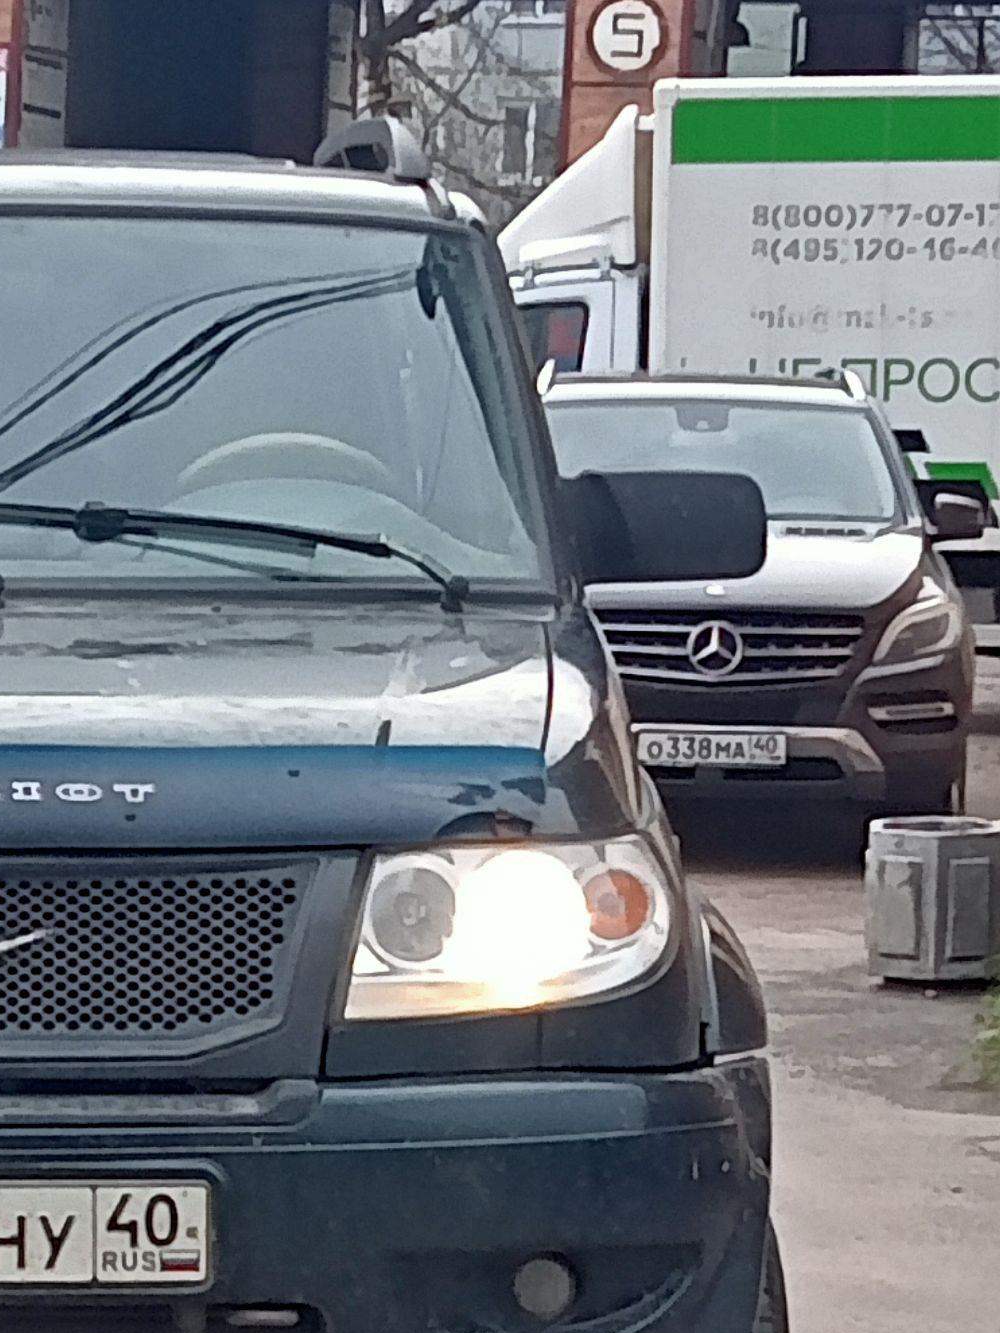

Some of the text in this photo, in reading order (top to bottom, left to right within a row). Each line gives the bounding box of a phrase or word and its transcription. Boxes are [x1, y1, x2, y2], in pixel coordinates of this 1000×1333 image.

[753, 735, 778, 755] 40
[106, 1193, 179, 1248] 40
[101, 1251, 157, 1273] RUS
